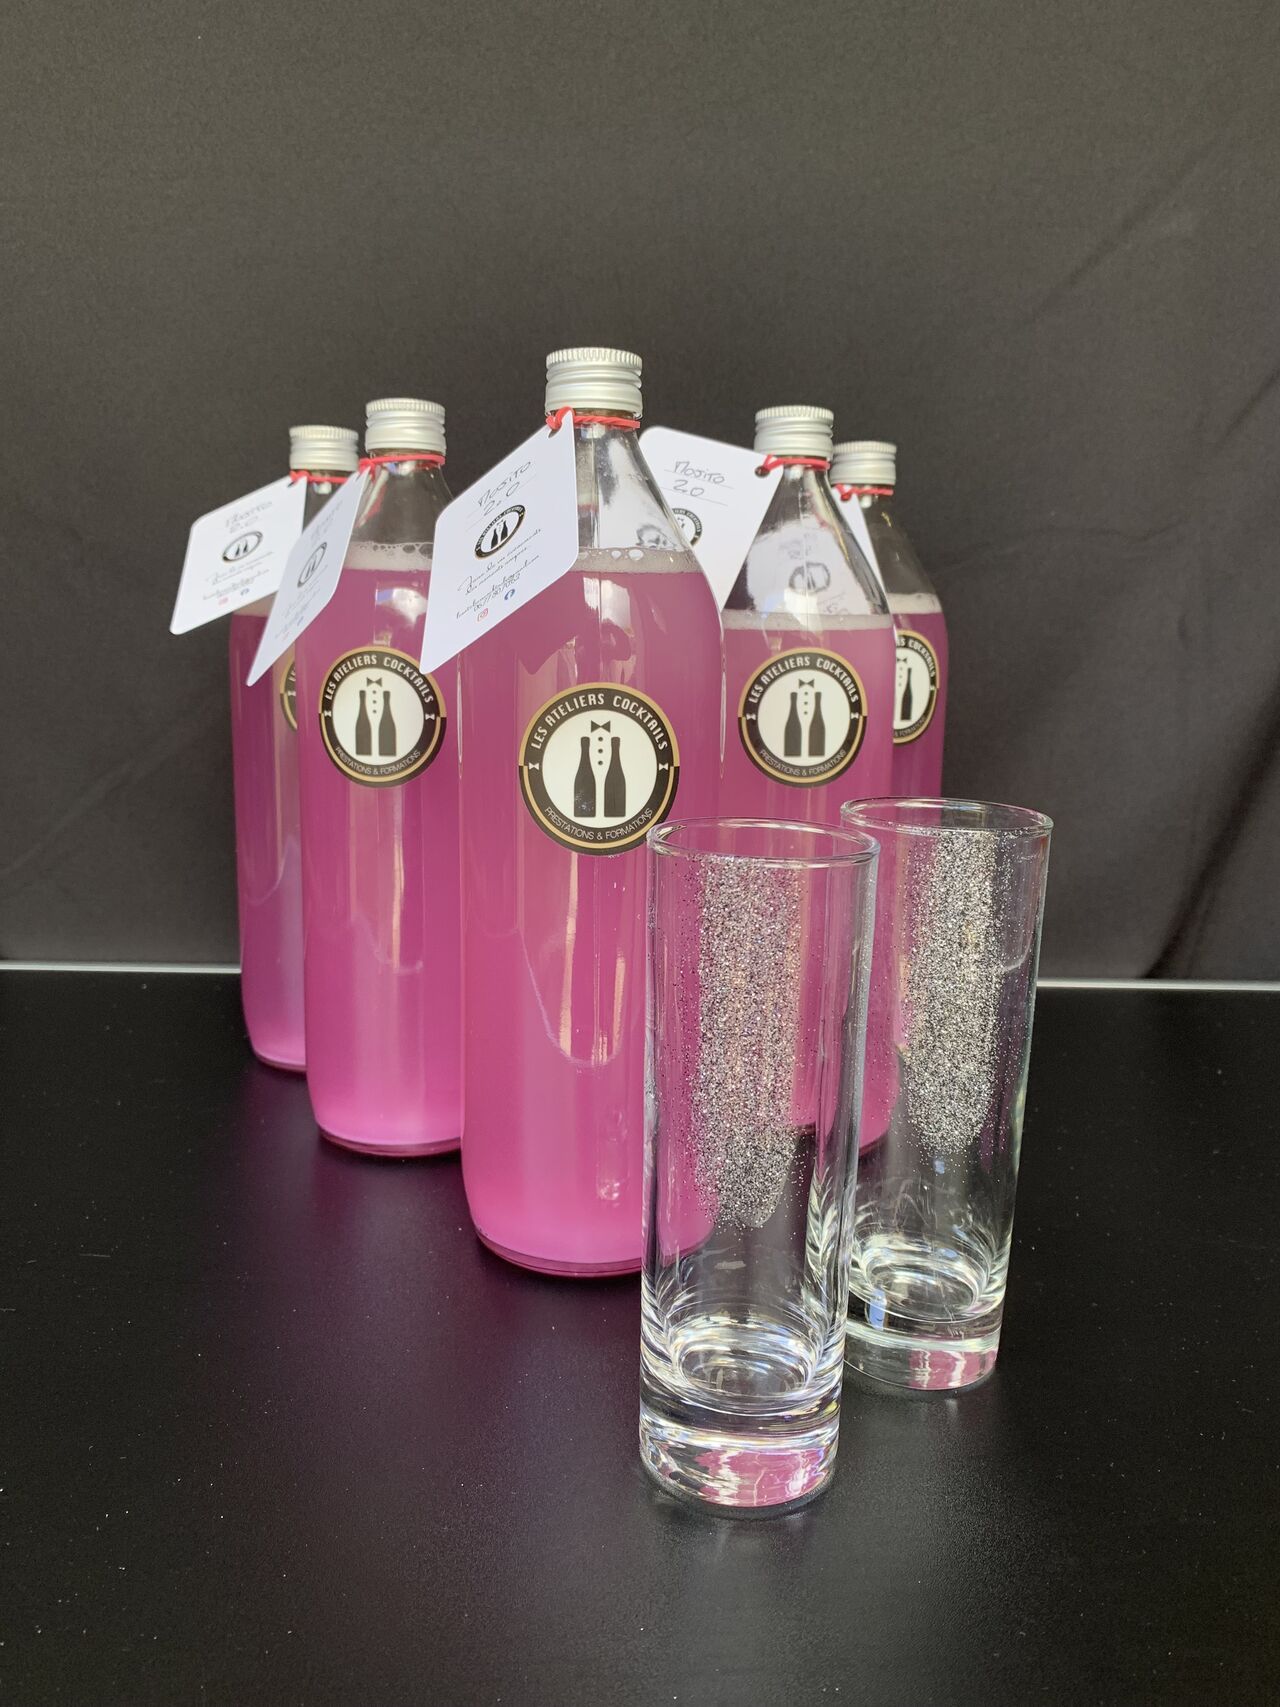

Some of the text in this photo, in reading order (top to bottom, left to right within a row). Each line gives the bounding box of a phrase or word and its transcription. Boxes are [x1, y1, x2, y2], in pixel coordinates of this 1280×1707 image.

[324, 654, 434, 703] LES ATELIERS COCKTAILS
[748, 656, 859, 704] LES ATELIERS COCKTAILS
[531, 693, 668, 751] LES ATELIERS COCKTAILS
[544, 807, 653, 840] PRESTATIONS & FORMATIONS
